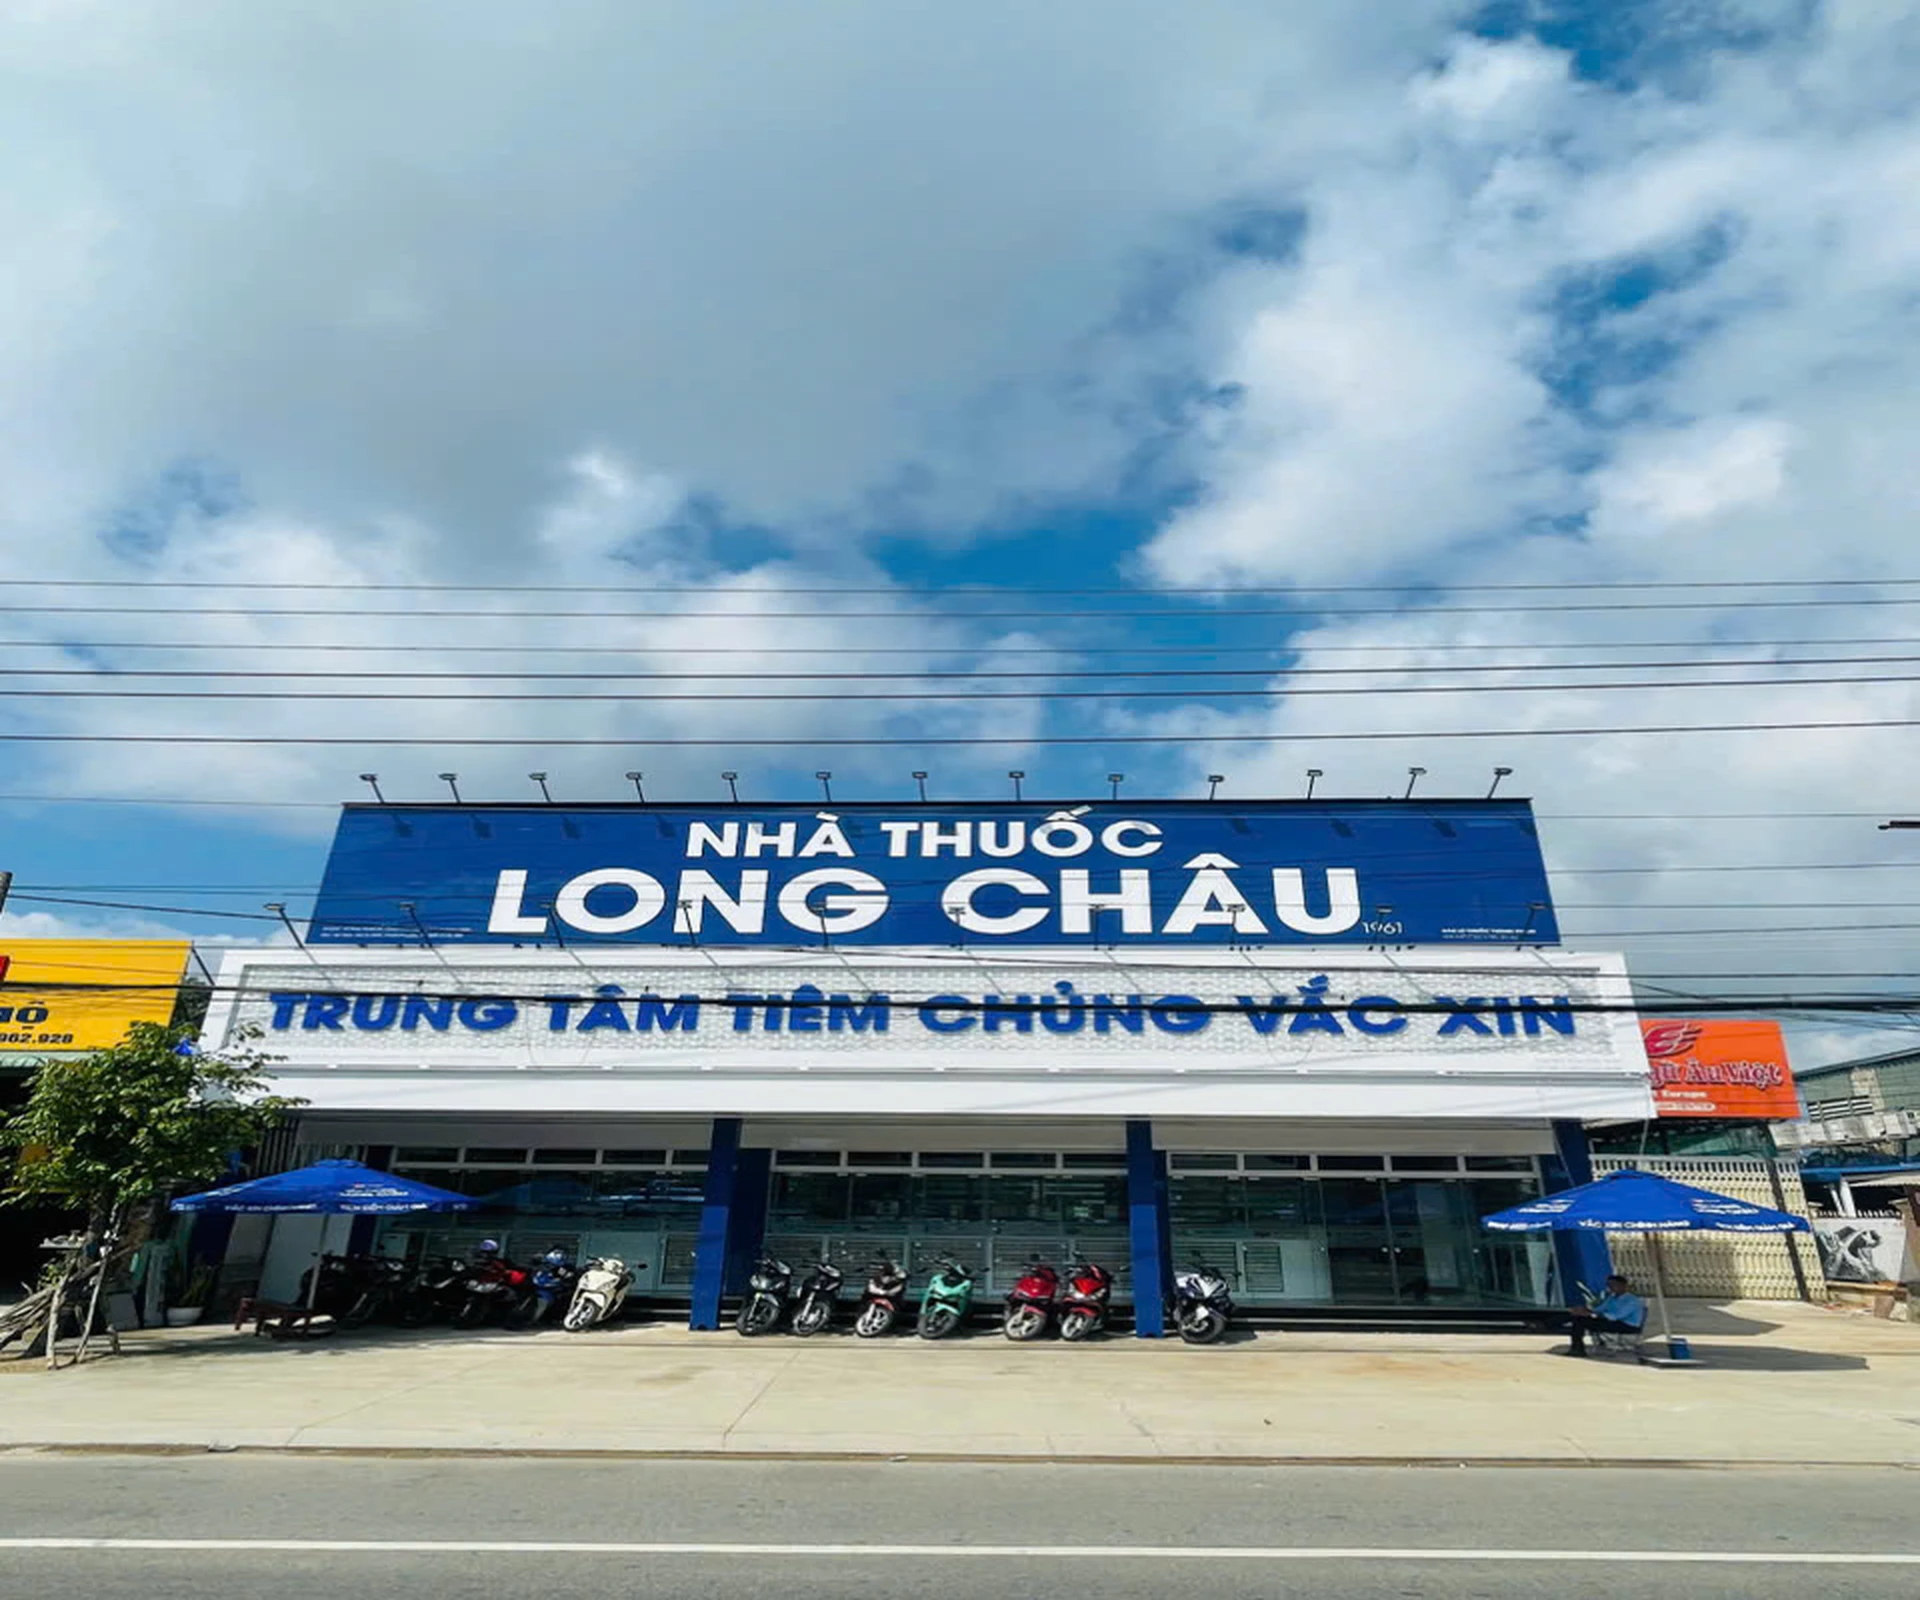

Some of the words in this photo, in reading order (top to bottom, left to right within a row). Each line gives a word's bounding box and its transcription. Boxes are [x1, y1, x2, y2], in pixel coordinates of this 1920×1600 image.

[686, 811, 856, 858] NHÀ
[880, 804, 1164, 858] THUỐC
[487, 867, 890, 935] LONG
[941, 852, 1362, 935] CHÂU
[269, 993, 519, 1032] TRUNG
[544, 984, 701, 1032] TÂM
[725, 984, 890, 1033] TIÊM
[918, 981, 1213, 1035] CHỦNG
[1236, 974, 1407, 1036] VẮC
[1432, 995, 1576, 1036] XIN
